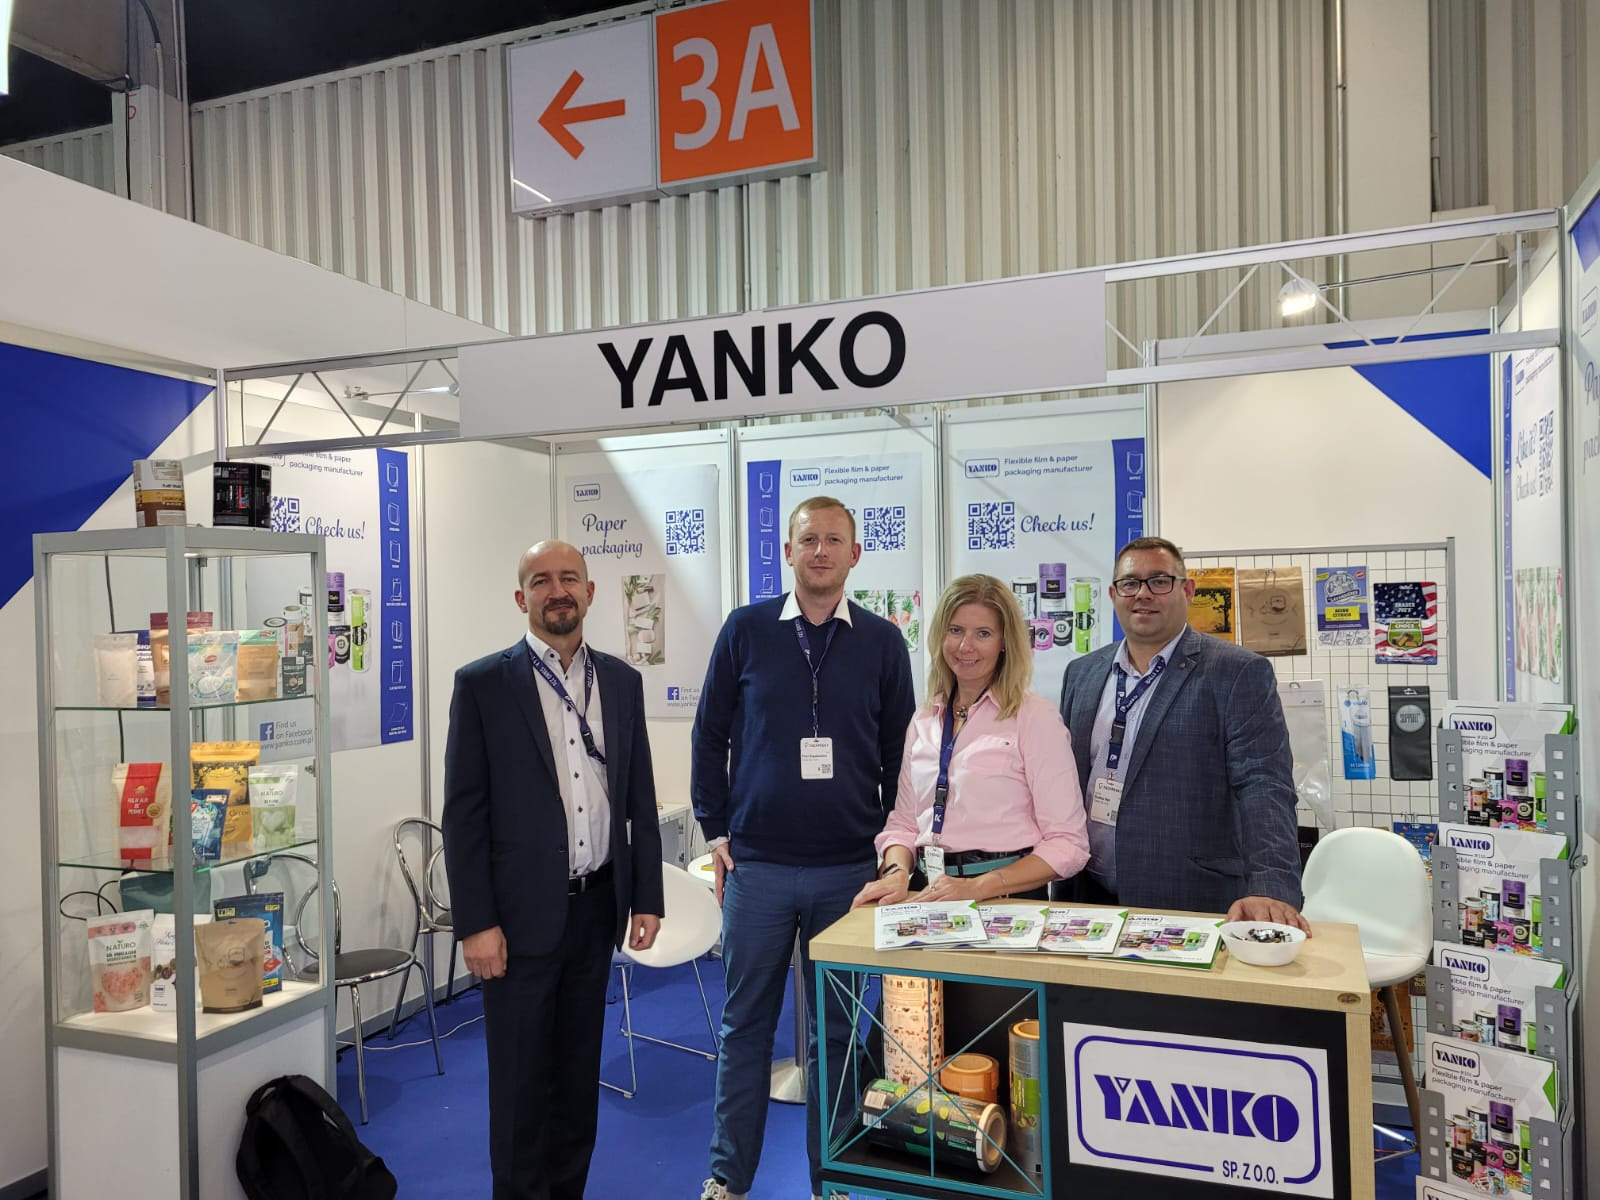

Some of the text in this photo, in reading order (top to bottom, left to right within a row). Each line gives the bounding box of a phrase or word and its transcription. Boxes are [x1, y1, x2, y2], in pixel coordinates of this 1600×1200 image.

[672, 23, 801, 151] 3A
[597, 311, 906, 409] YANKO
[334, 454, 352, 464] paper
[1004, 456, 1033, 465] Flexible
[1034, 455, 1048, 464] film
[1056, 454, 1078, 465] paper
[289, 460, 363, 477] packaging manufacturer
[824, 467, 850, 475] Flexible
[865, 465, 870, 473] &
[871, 464, 890, 474] paper
[967, 463, 997, 474] YANKO
[1004, 464, 1093, 477] packaging manufacturer
[793, 474, 819, 482] YANKO
[824, 474, 904, 486] packaging manufacturer
[576, 488, 599, 497] YANKO
[305, 516, 366, 540] Check us!
[582, 513, 627, 539] Paper
[1020, 512, 1096, 534] Check us!
[582, 538, 643, 560] packaging
[276, 721, 289, 729] Find
[1453, 720, 1493, 732] YANKO
[1484, 748, 1532, 757] manufacturer
[1496, 741, 1518, 750] paper
[1450, 836, 1491, 851] YANKO
[1474, 858, 1487, 867] film
[1494, 862, 1516, 870] paper
[1481, 868, 1529, 880] manufacturer
[106, 942, 136, 951] NATURO
[1445, 956, 1487, 974] YANKO
[1468, 980, 1482, 990] film
[1490, 986, 1512, 995] paper
[1476, 991, 1525, 1005] manufacturer
[1435, 1049, 1477, 1070] YANKO
[1432, 1068, 1458, 1081] Flexible
[1459, 1075, 1473, 1085] film
[1473, 1079, 1480, 1087] &
[1481, 1081, 1503, 1092] paper
[1431, 1077, 1517, 1103] packaging manufacturer
[1094, 1074, 1300, 1143] YANKO
[1222, 1160, 1240, 1179] SP.
